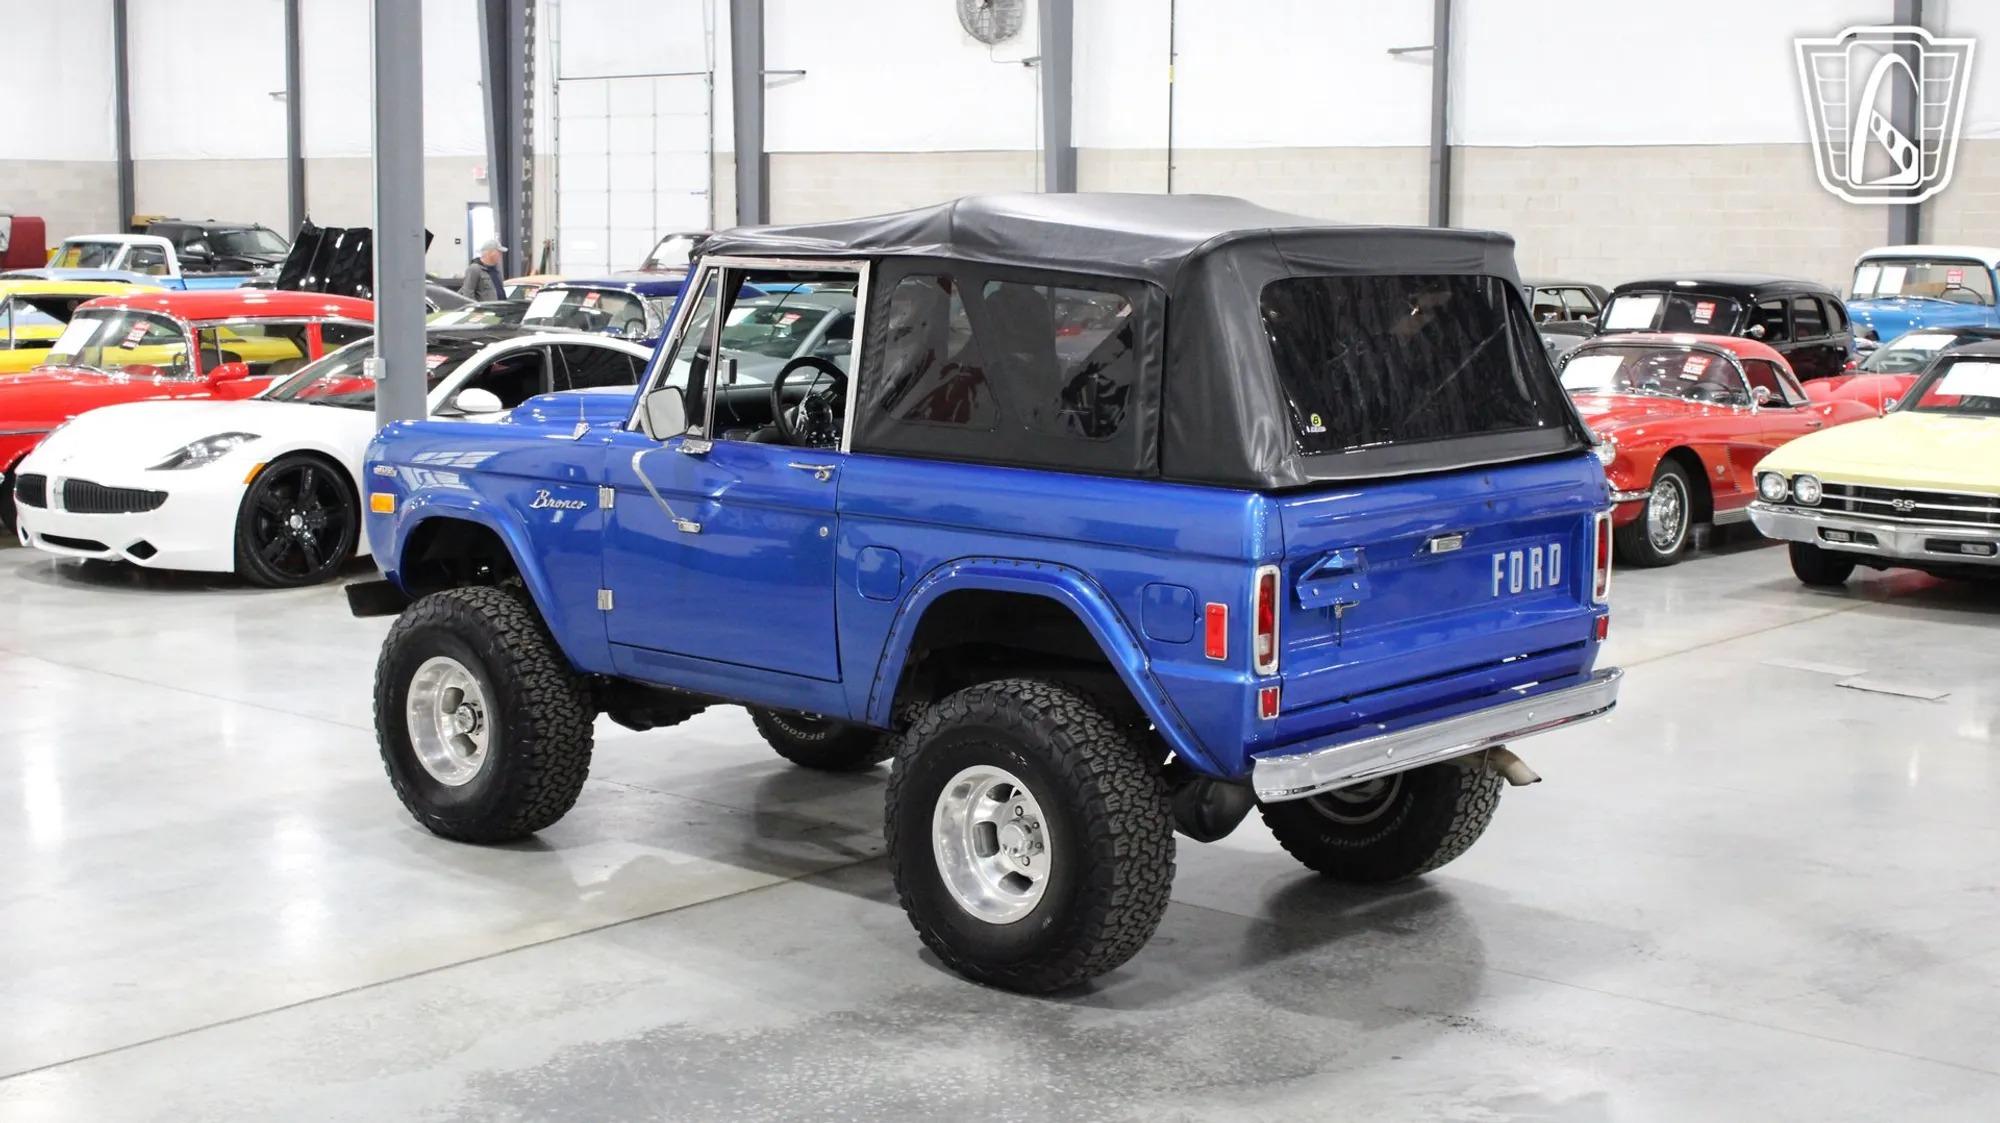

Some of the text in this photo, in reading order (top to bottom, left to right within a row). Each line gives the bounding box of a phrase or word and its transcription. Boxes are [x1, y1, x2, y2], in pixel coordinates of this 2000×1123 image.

[529, 489, 587, 510] Bronco
[1891, 498, 1915, 509] SS
[1492, 543, 1562, 597] FORD
[767, 709, 826, 741] BFGoodr
